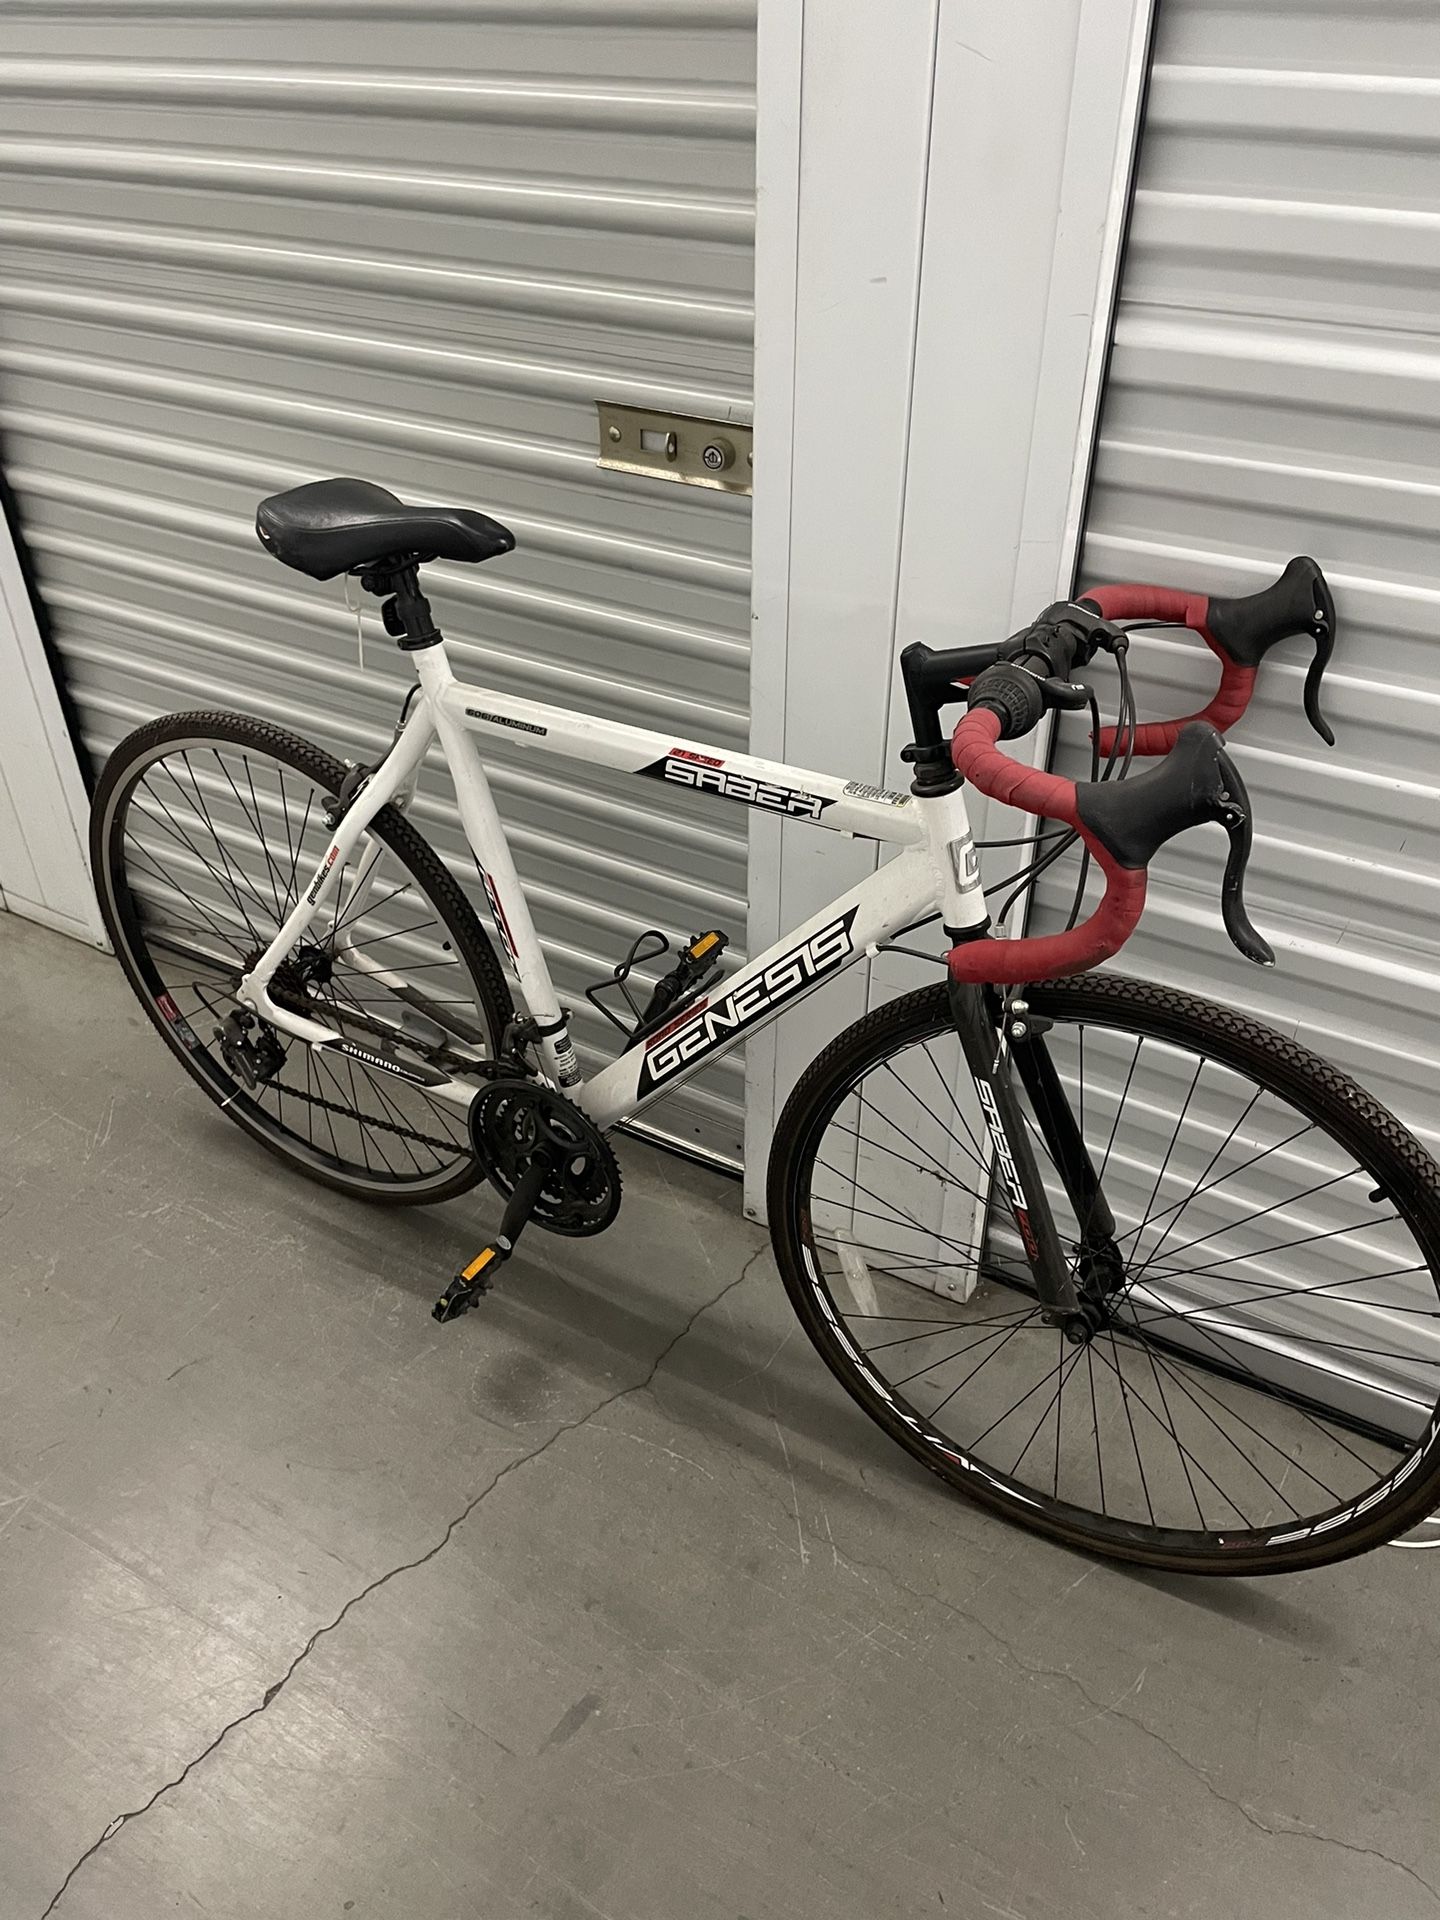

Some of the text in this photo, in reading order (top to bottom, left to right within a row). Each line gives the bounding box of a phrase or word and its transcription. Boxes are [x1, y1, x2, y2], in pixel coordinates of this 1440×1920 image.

[664, 758, 823, 819] SABER
[646, 919, 851, 1081] GENESIS
[974, 1076, 1029, 1211] SABER
